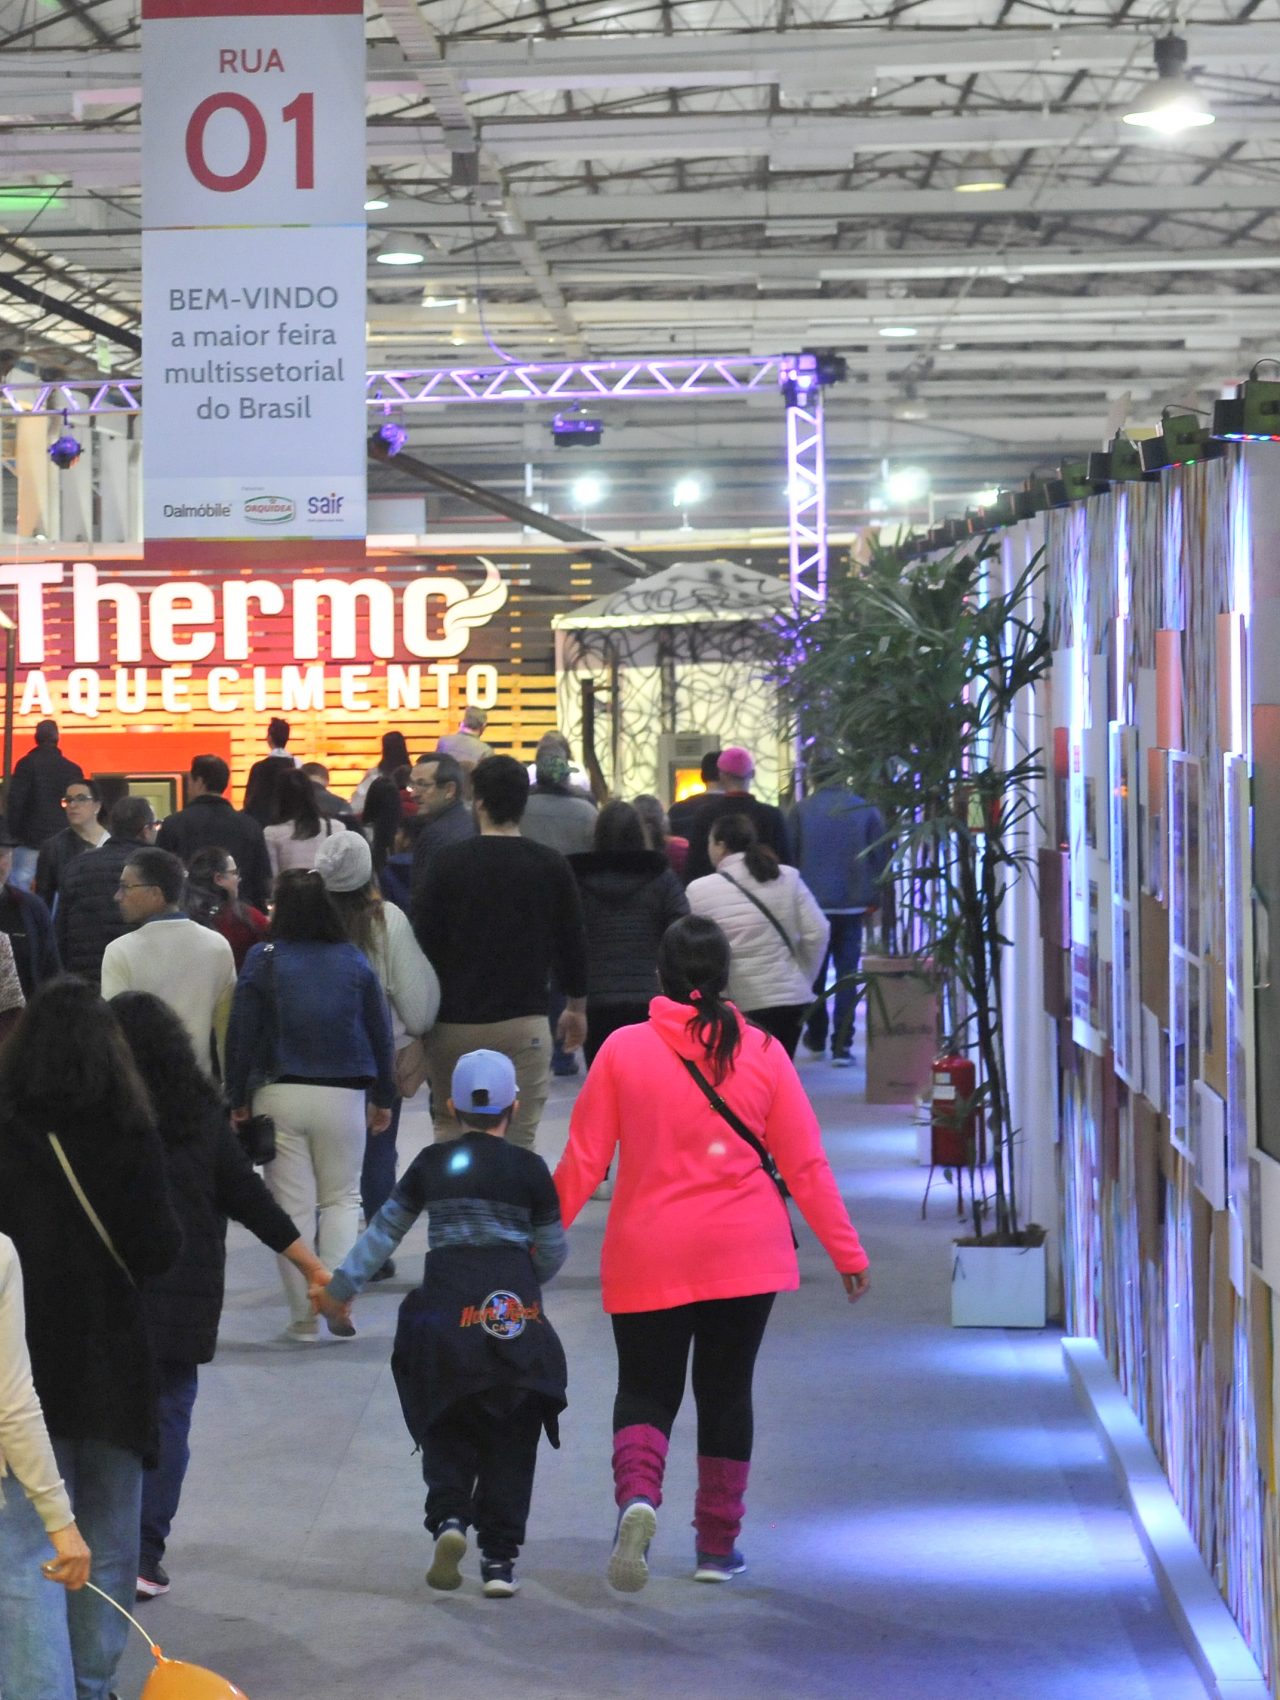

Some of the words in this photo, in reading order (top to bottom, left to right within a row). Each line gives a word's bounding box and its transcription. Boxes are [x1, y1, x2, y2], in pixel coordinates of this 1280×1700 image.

[219, 48, 285, 74] RUA
[185, 91, 314, 192] 01
[169, 286, 339, 311] BEM-VINDO
[171, 331, 185, 347] a
[193, 324, 270, 347] maior
[278, 322, 337, 345] feira
[165, 358, 344, 383] multissetorial
[196, 397, 230, 419] do
[239, 395, 311, 419] Brasil
[19, 664, 498, 718] AQUECIMENTO
